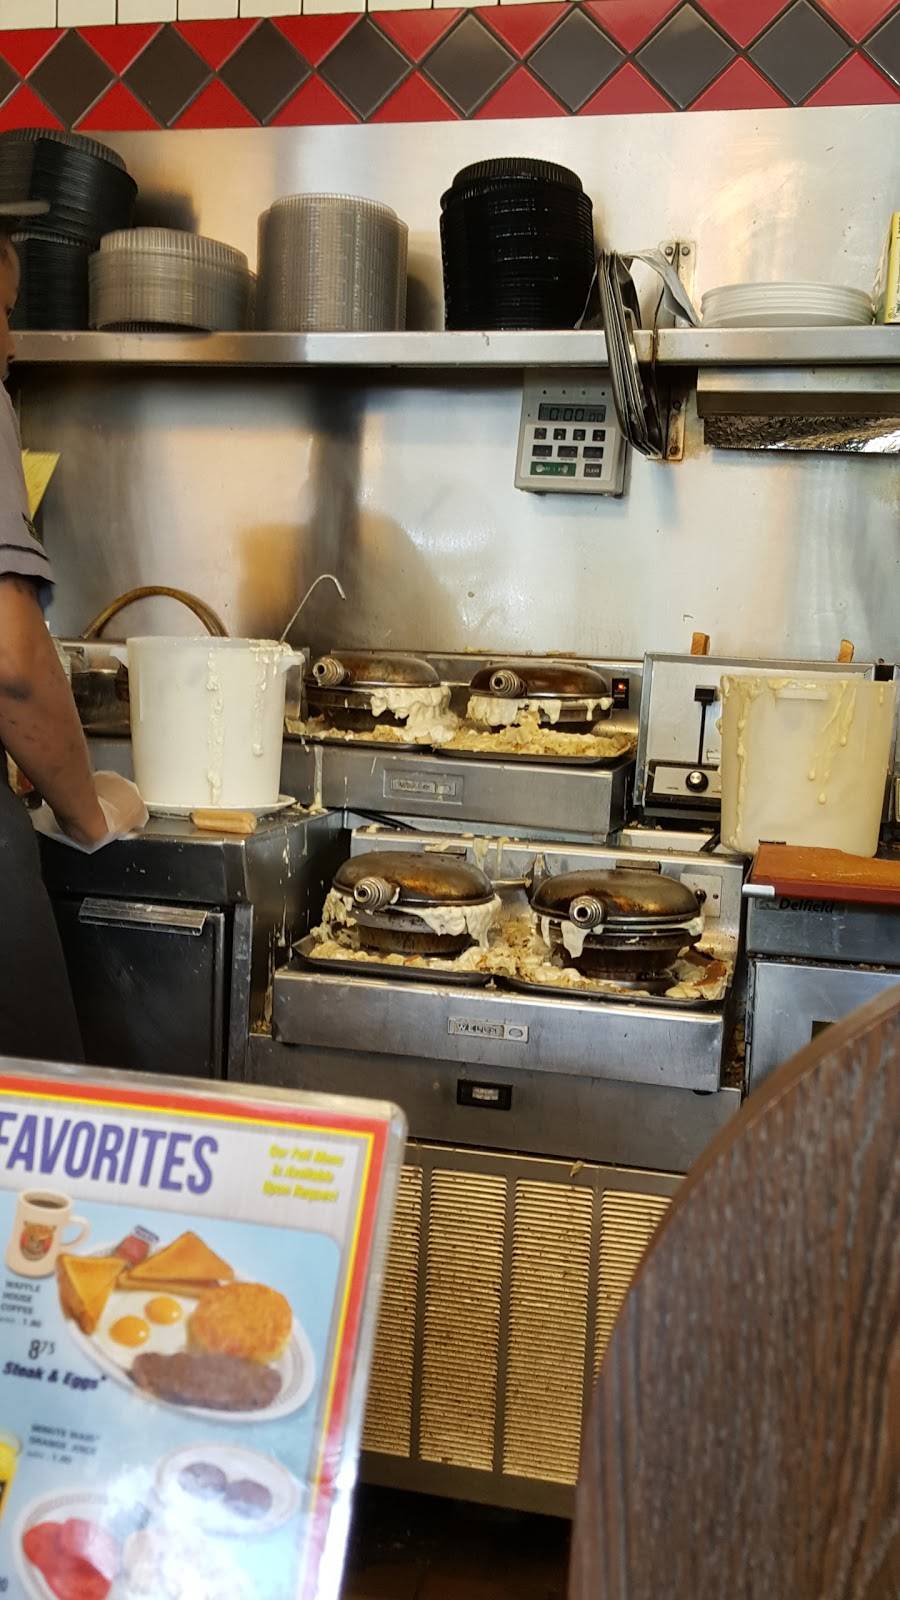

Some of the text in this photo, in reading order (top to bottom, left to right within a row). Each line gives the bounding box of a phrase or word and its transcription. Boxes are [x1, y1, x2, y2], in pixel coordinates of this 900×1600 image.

[779, 897, 833, 914] Delfield
[3, 1361, 43, 1381] Steak
[47, 1367, 58, 1383] &
